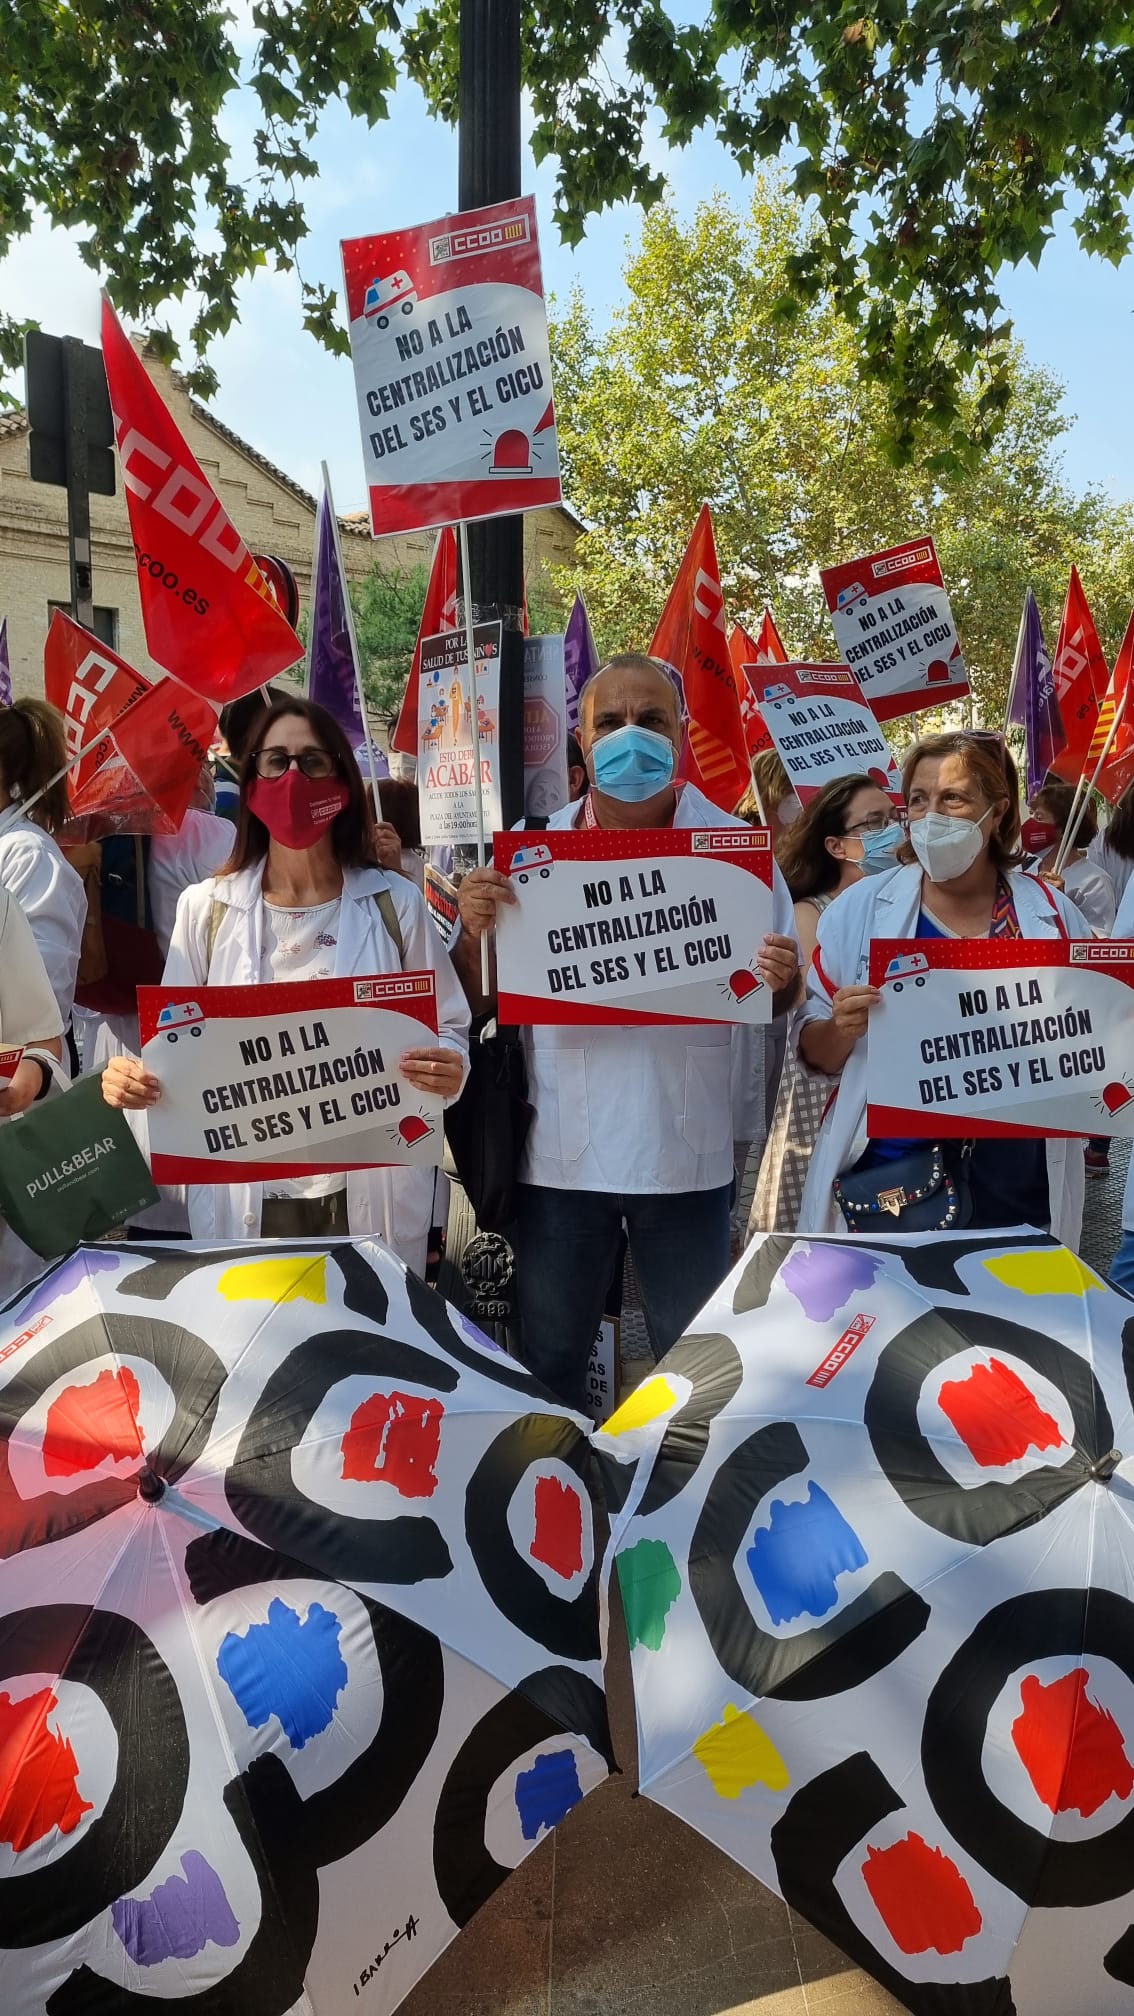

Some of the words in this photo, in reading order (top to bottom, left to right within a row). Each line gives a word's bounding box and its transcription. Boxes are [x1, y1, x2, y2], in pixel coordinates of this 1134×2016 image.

[454, 230, 503, 252] CCOO
[395, 333, 423, 361] NO
[428, 320, 444, 348] A
[444, 304, 472, 338] LA
[366, 326, 525, 417] CENTRALIZACIÓN
[370, 429, 408, 459] DEL
[410, 406, 446, 442] SES
[448, 399, 461, 422] Y
[466, 386, 494, 416] EL
[496, 362, 544, 404] CICU
[887, 554, 916, 571] CCOO
[858, 612, 876, 632] NO
[878, 606, 888, 622] A
[888, 598, 906, 616] LA
[446, 637, 459, 650] POR
[460, 636, 467, 647] L
[845, 605, 938, 665] CENTRALIZACIÓN
[874, 652, 896, 674] SES
[896, 646, 906, 660] Y
[908, 637, 924, 656] EL
[922, 622, 952, 648] CICU
[423, 656, 444, 670] SALUD
[445, 653, 454, 665] DE
[456, 650, 468, 662] TUS
[812, 673, 837, 681] CCOO
[788, 712, 808, 726] NO
[806, 708, 820, 720] A
[818, 704, 836, 718] LA
[779, 718, 868, 751] CENTRALIZACIÓN
[426, 760, 492, 788] ACABAR
[440, 752, 456, 762] ESTO
[786, 756, 812, 772] DEL
[810, 748, 836, 766] SES
[832, 744, 844, 758] Y
[842, 744, 860, 756] EL
[856, 738, 884, 754] CICU
[451, 821, 467, 829] 19:00
[712, 836, 750, 846] CCOO
[582, 880, 612, 908] NO
[618, 876, 634, 902] A
[638, 870, 666, 898] LA
[547, 896, 717, 954] CENTRALIZACIÓN
[548, 964, 586, 994] DEL
[590, 956, 630, 984] SES
[634, 952, 646, 976] Y
[654, 946, 680, 972] EL
[684, 934, 732, 966] CICU
[1090, 948, 1128, 958] CCOO
[375, 982, 413, 995] CCOO
[958, 990, 988, 1018] NO
[996, 986, 1010, 1012] A
[1016, 980, 1042, 1008] LA
[238, 1036, 272, 1066] NO
[278, 1030, 296, 1058] A
[298, 1022, 330, 1052] LA
[920, 1006, 1093, 1064] CENTRALIZACIÓN
[202, 1046, 386, 1114] CENTRALIZACIÓN
[918, 1074, 958, 1104] DEL
[962, 1066, 1002, 1096] SES
[1006, 1062, 1020, 1088] Y
[1028, 1058, 1054, 1084] EL
[1058, 1046, 1106, 1078] CICU
[204, 1124, 248, 1154] DEL
[252, 1112, 294, 1142] SES
[298, 1106, 312, 1130] Y
[318, 1098, 346, 1126] EL
[350, 1082, 400, 1116] CICU
[26, 1137, 117, 1198] PULL&BEAR
[823, 1333, 859, 1371] CCOO
